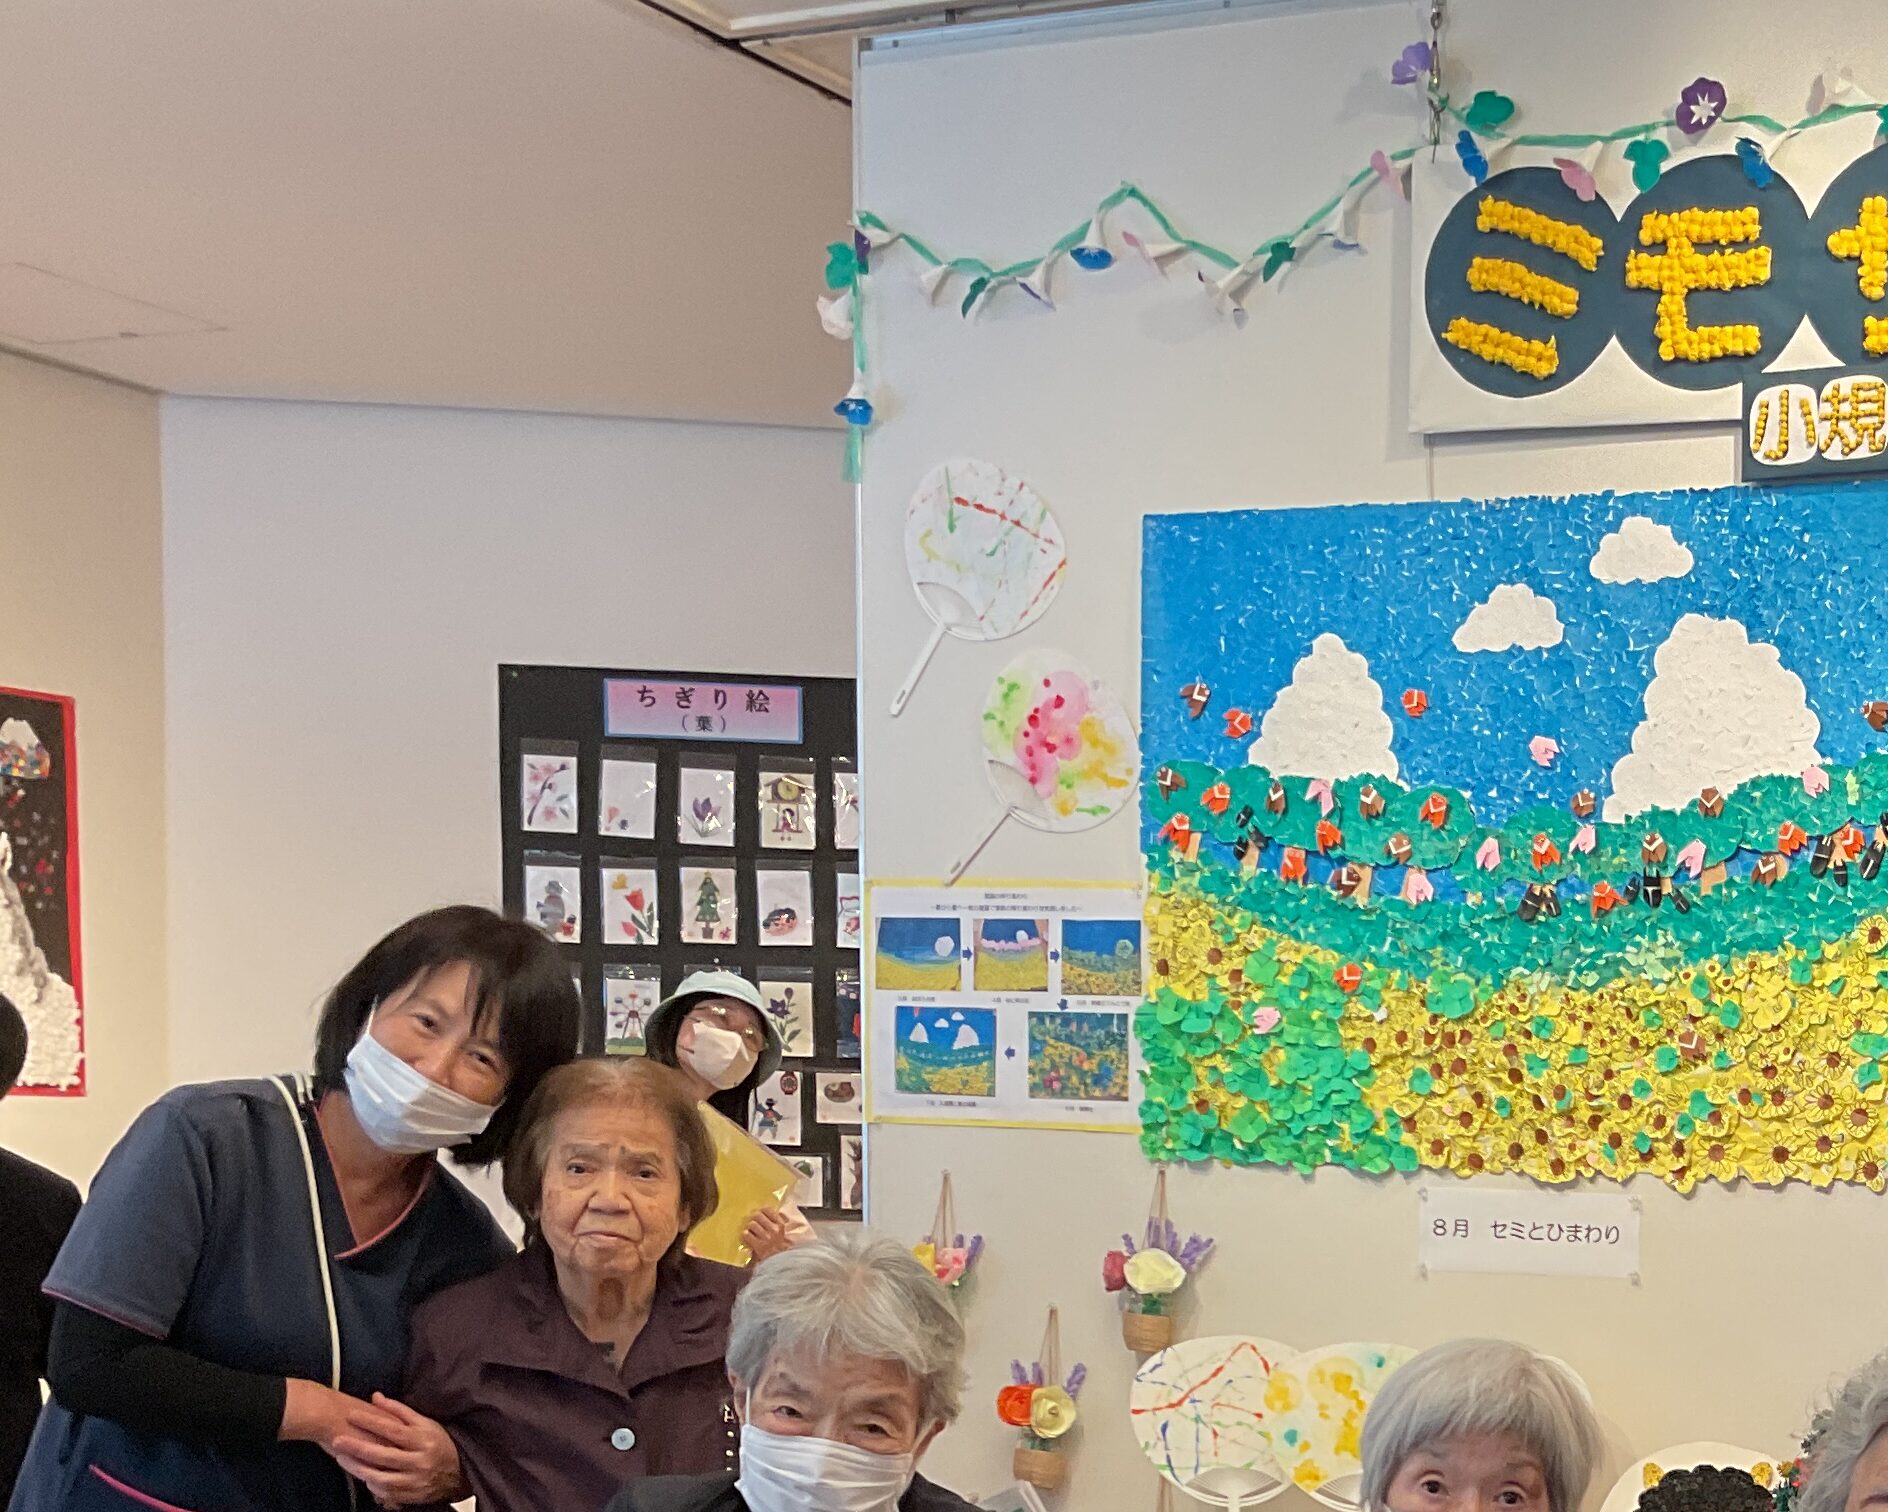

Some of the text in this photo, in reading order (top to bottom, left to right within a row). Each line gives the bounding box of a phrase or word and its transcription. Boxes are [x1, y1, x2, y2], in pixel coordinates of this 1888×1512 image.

[637, 685, 771, 713] ちぎり絵
[1490, 1220, 1620, 1244] セミとひまわり
